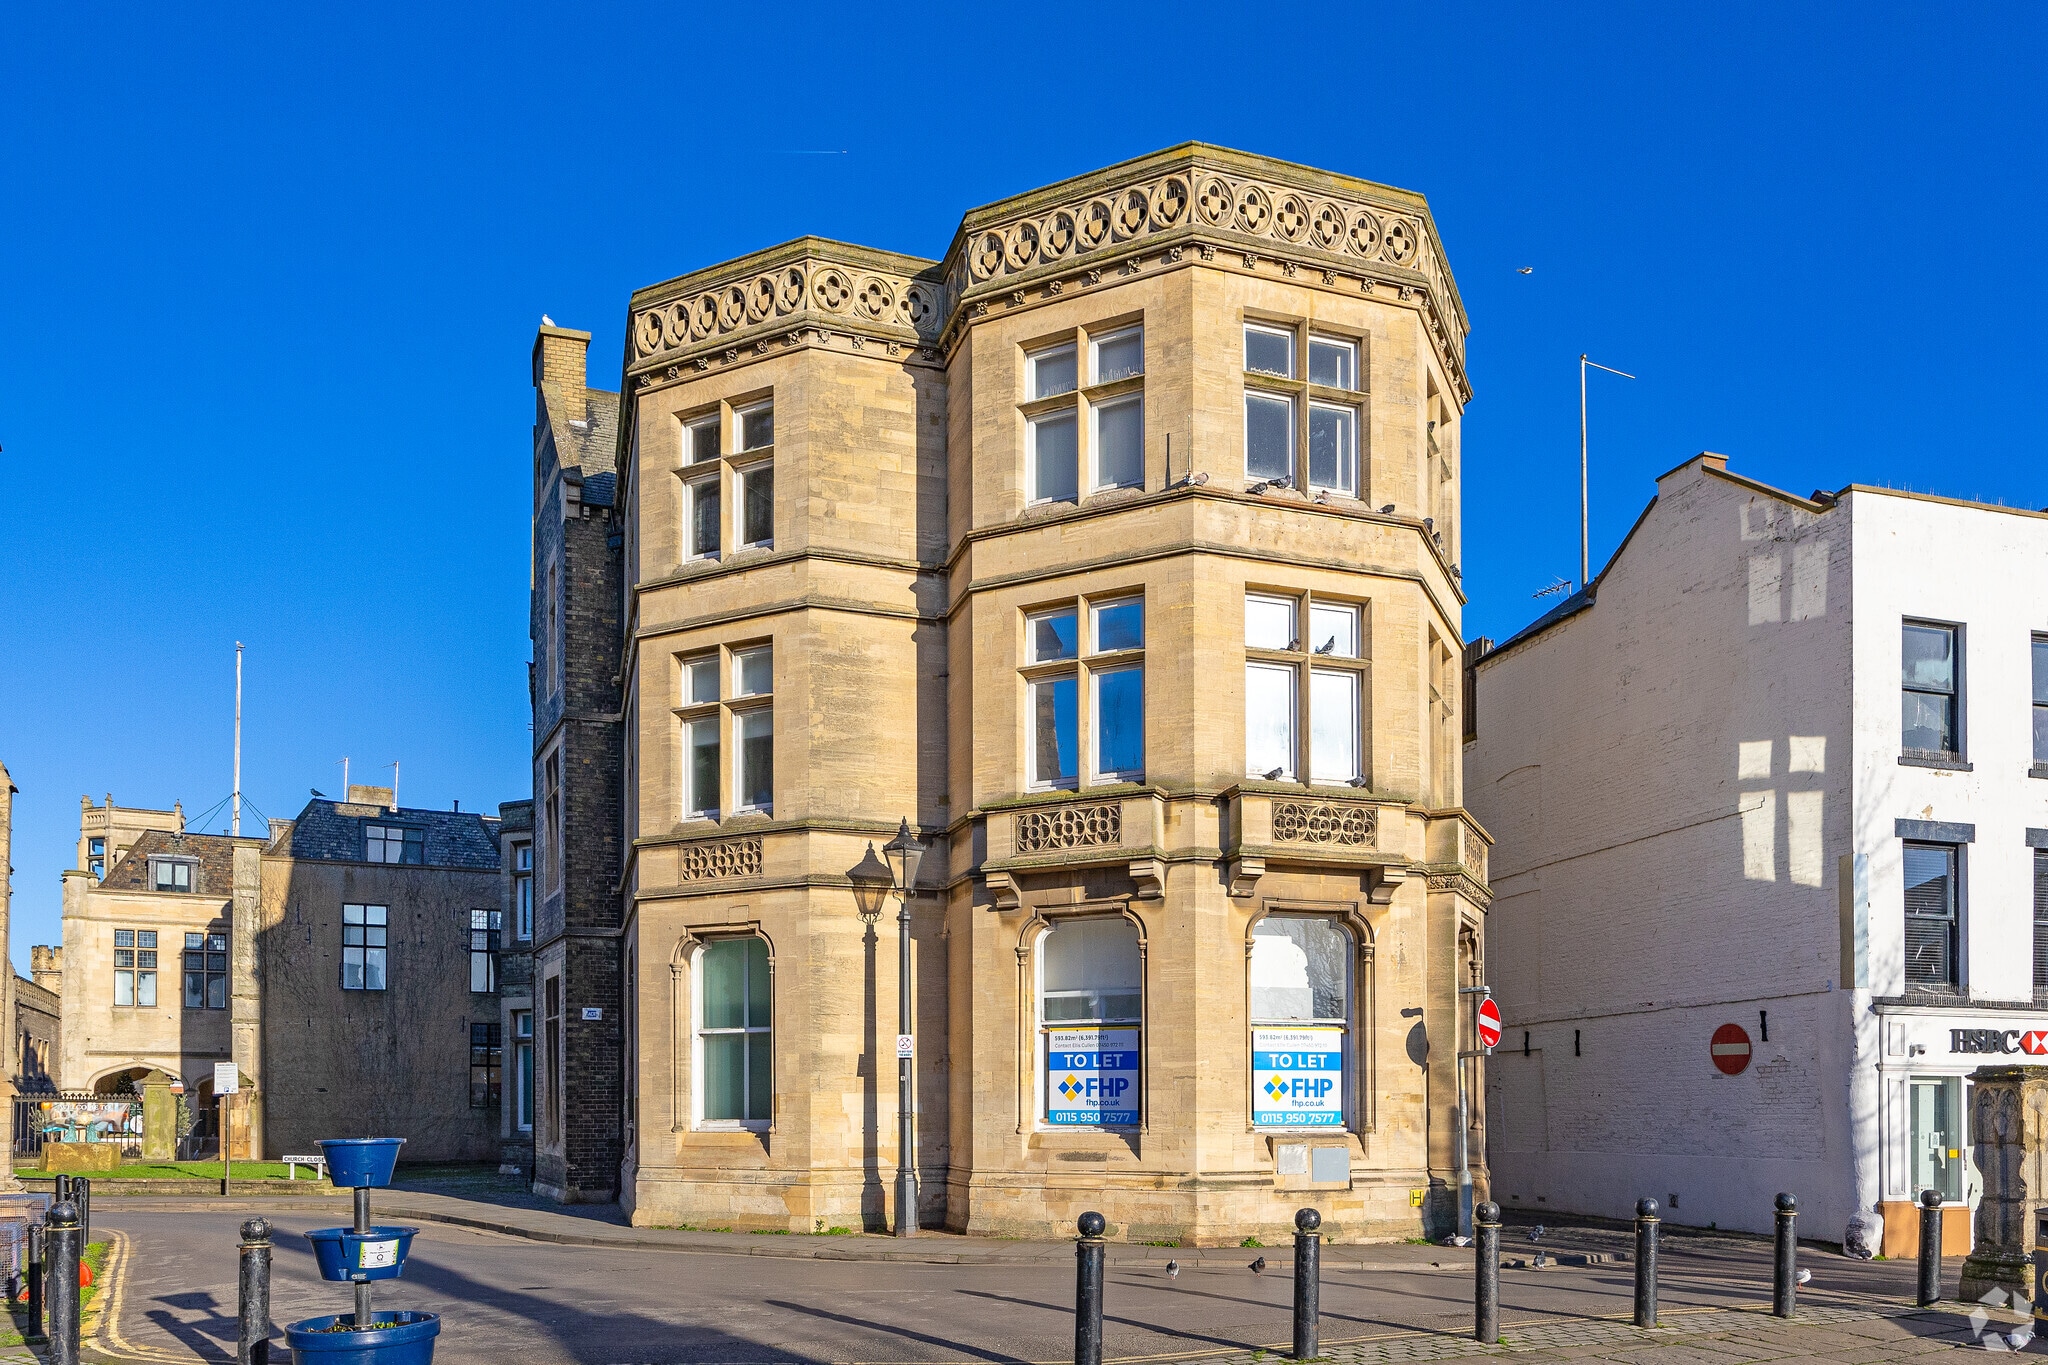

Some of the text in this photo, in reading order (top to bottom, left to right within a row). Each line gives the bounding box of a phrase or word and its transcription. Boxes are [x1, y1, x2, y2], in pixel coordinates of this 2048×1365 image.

[1949, 1029, 2020, 1054] HSBC
[1064, 1054, 1123, 1068] TO LET
[1269, 1054, 1327, 1068] TO LET
[1086, 1078, 1129, 1097] FHP
[1292, 1078, 1333, 1098] FHP
[1086, 1099, 1120, 1107] fhp.co.uk
[1292, 1100, 1324, 1108] fhp.co.uk
[1056, 1112, 1130, 1122] 0115 950 7577
[1261, 1113, 1335, 1123] 0115 950 7577
[1412, 1191, 1422, 1205] H
